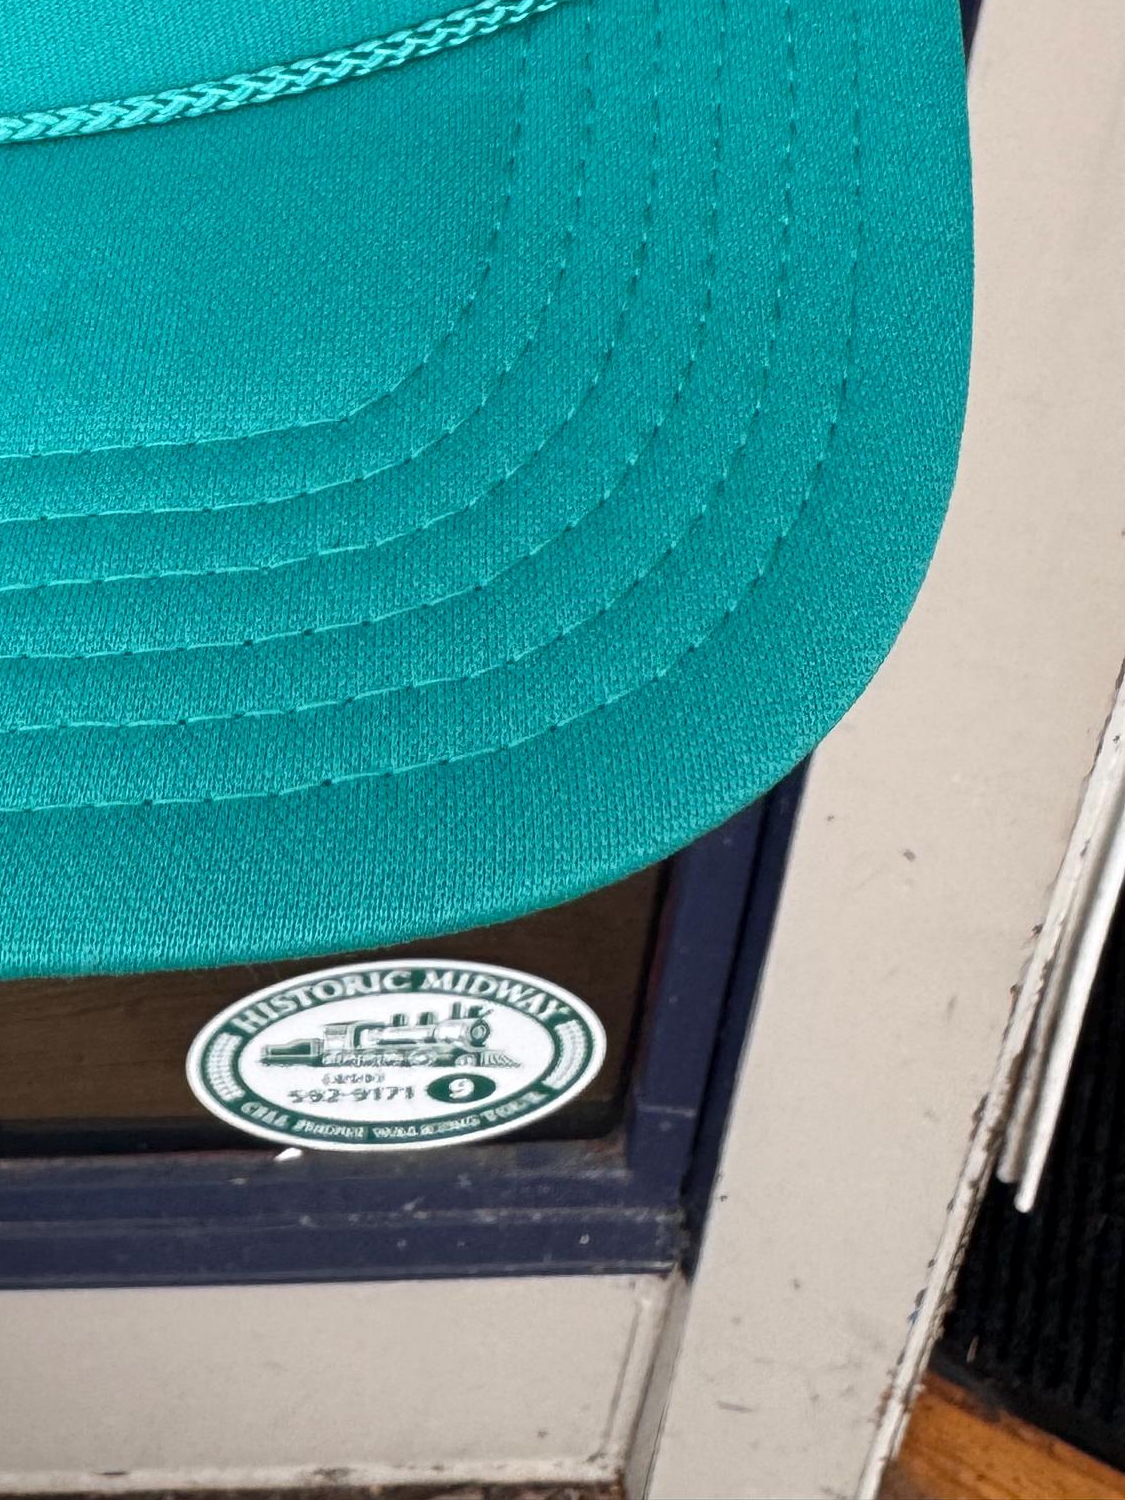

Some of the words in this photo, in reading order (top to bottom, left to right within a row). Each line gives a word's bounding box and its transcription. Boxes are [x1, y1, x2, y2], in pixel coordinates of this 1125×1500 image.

[231, 970, 413, 1034] HISTORIC
[421, 970, 572, 1024] MIDWAY
[448, 1077, 475, 1100] 9
